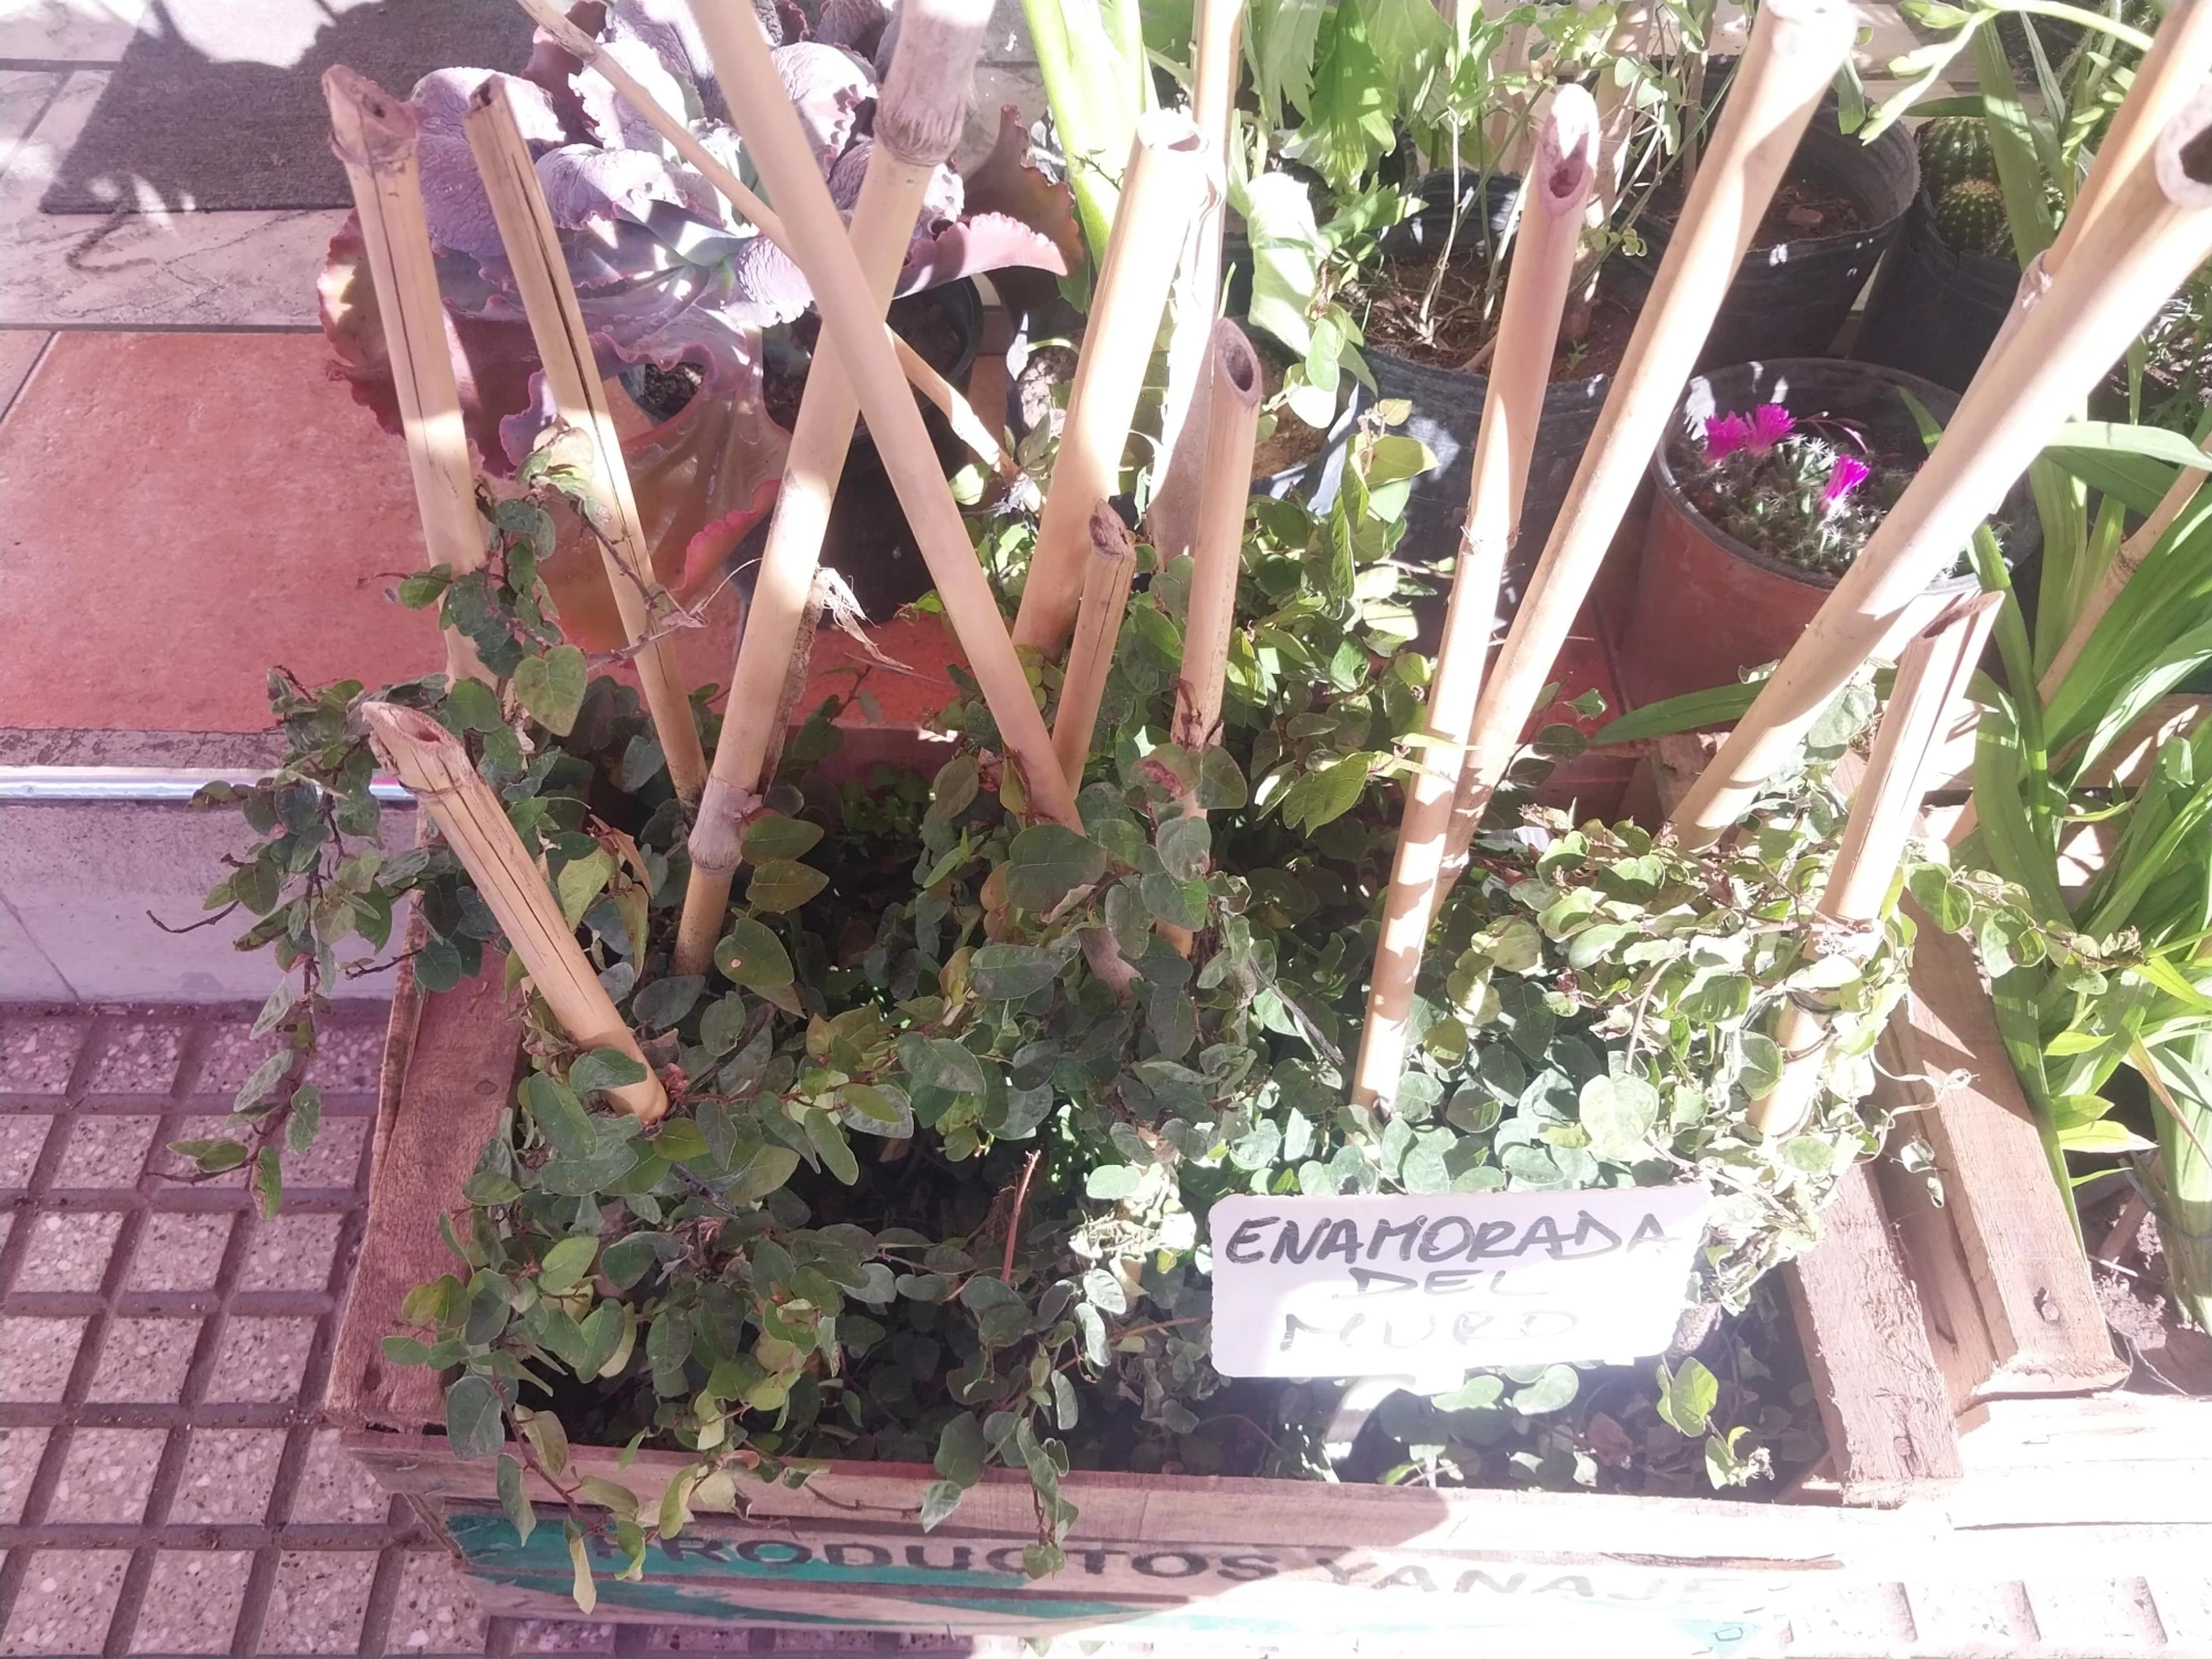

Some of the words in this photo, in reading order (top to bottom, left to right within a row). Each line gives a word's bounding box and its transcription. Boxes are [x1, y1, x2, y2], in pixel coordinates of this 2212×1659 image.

[1225, 1210, 1681, 1265] ENAMORADA
[1331, 1267, 1550, 1300] DEL
[1279, 1309, 1578, 1353] MURO
